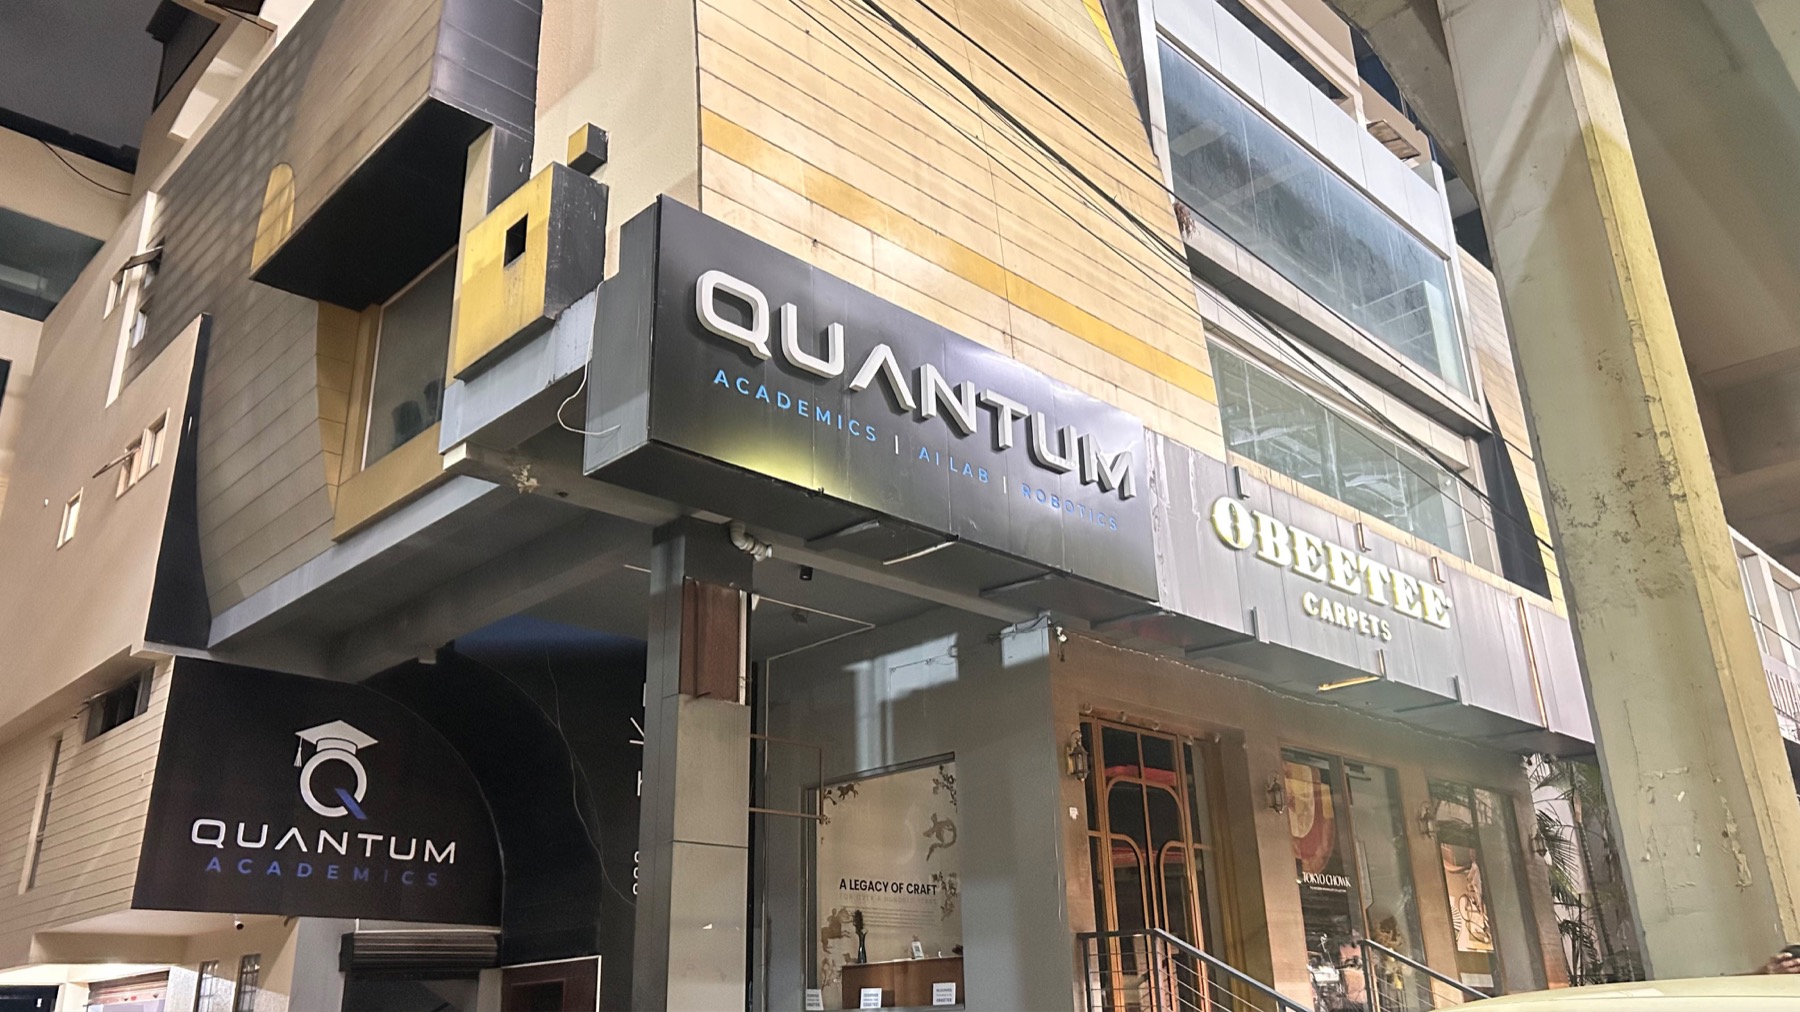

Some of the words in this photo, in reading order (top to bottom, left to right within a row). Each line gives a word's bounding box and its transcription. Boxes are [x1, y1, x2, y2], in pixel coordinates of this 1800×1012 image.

[695, 269, 1136, 498] QUANTUM
[713, 369, 877, 442] ACADEMICS
[918, 446, 940, 466] AI
[949, 454, 989, 483] LAB
[1021, 483, 1118, 531] ROBOTICS
[1211, 496, 1452, 629] OBEETEE
[1303, 591, 1392, 642] CARPETS
[191, 819, 456, 864] QUANTUM
[206, 856, 438, 886] ACADEMICS
[839, 878, 847, 890] A
[849, 879, 889, 892] LEGACY
[891, 882, 904, 894] OF
[906, 883, 937, 895] CRAFT
[1302, 871, 1325, 885] TOKYO
